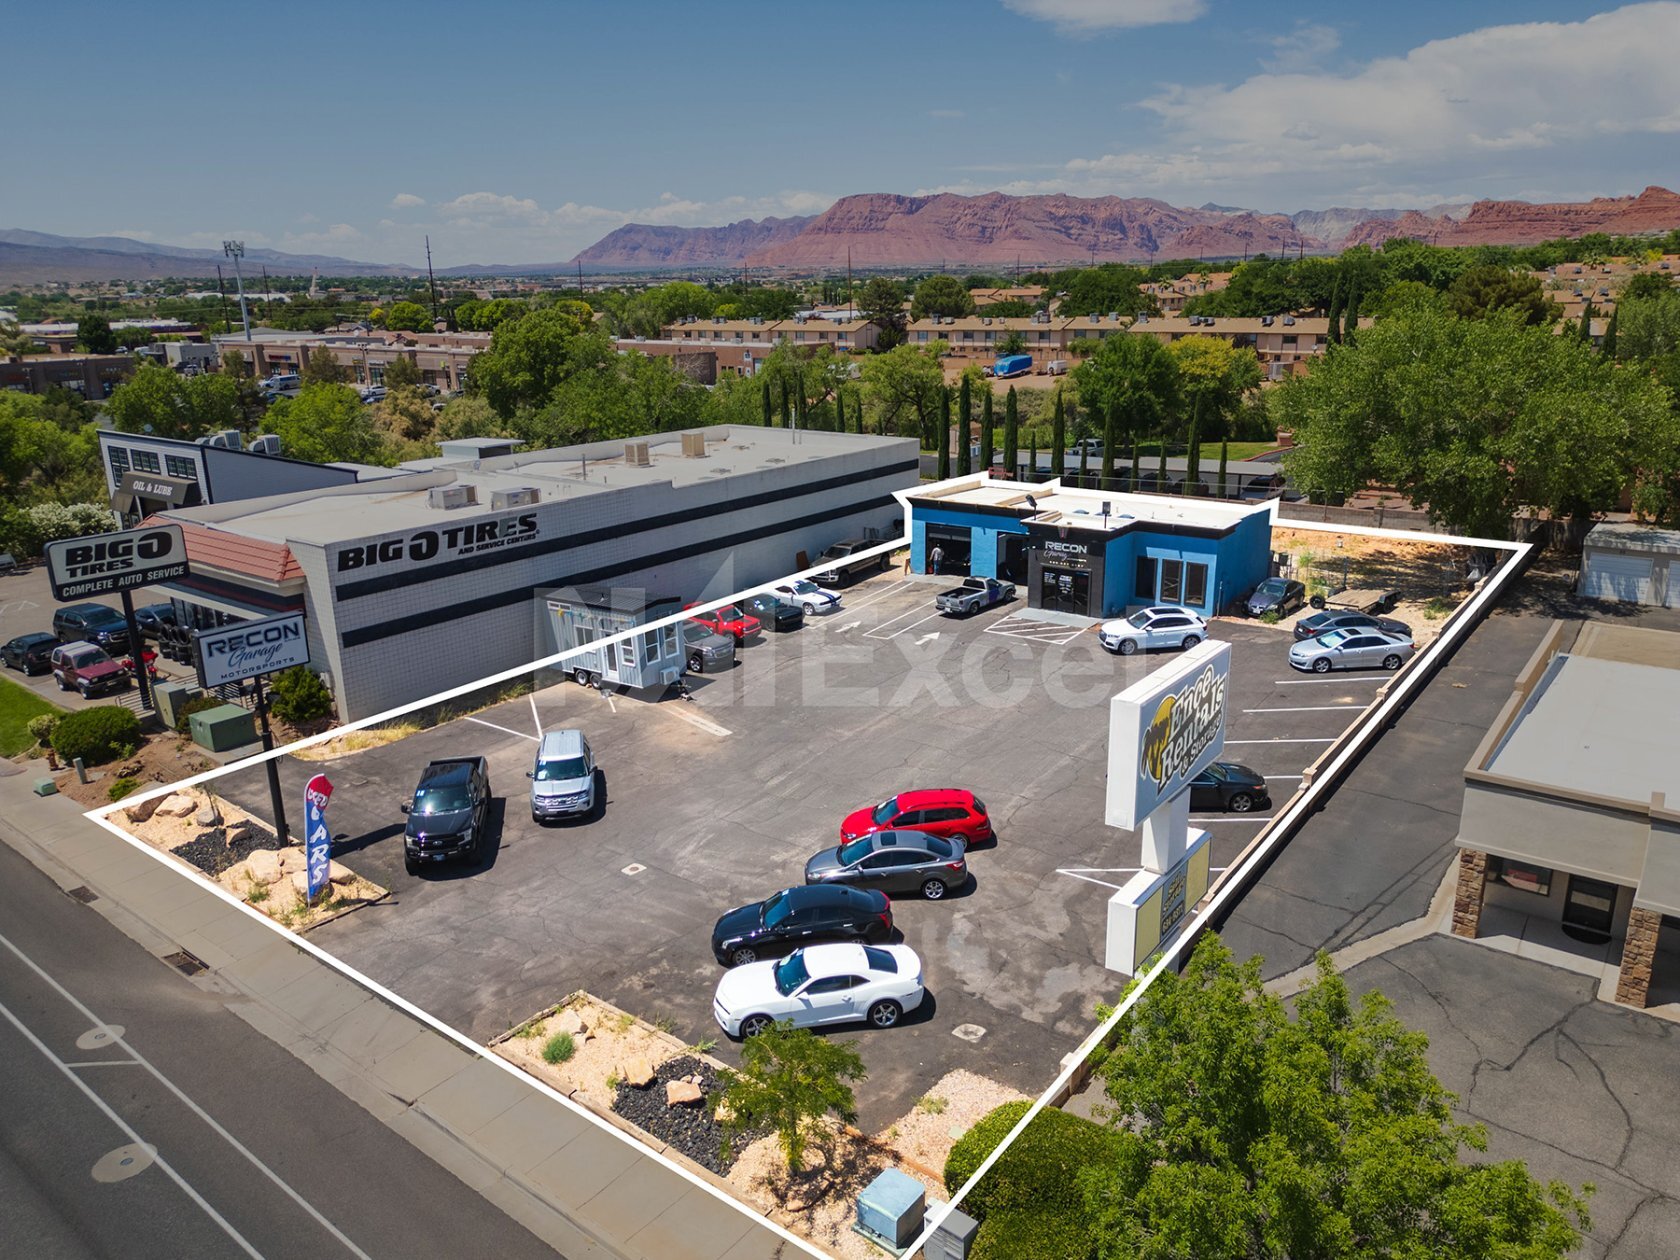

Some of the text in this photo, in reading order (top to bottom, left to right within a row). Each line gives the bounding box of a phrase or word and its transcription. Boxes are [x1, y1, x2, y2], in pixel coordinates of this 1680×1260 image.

[133, 481, 173, 496] OIL & LUBE
[66, 532, 172, 566] BIG O
[338, 513, 537, 572] BIG O TIRES
[458, 546, 474, 555] AND
[476, 540, 505, 551] SERVICE
[1045, 541, 1087, 554] RECON
[63, 565, 184, 597] COMPLETE AUTO SERVICE
[66, 557, 134, 578] TIRES
[206, 623, 299, 658] RECON
[221, 657, 295, 680] MOTORSPORTS
[228, 643, 283, 669] Garage
[1169, 669, 1212, 739] Ence
[1160, 679, 1225, 788] Rentals
